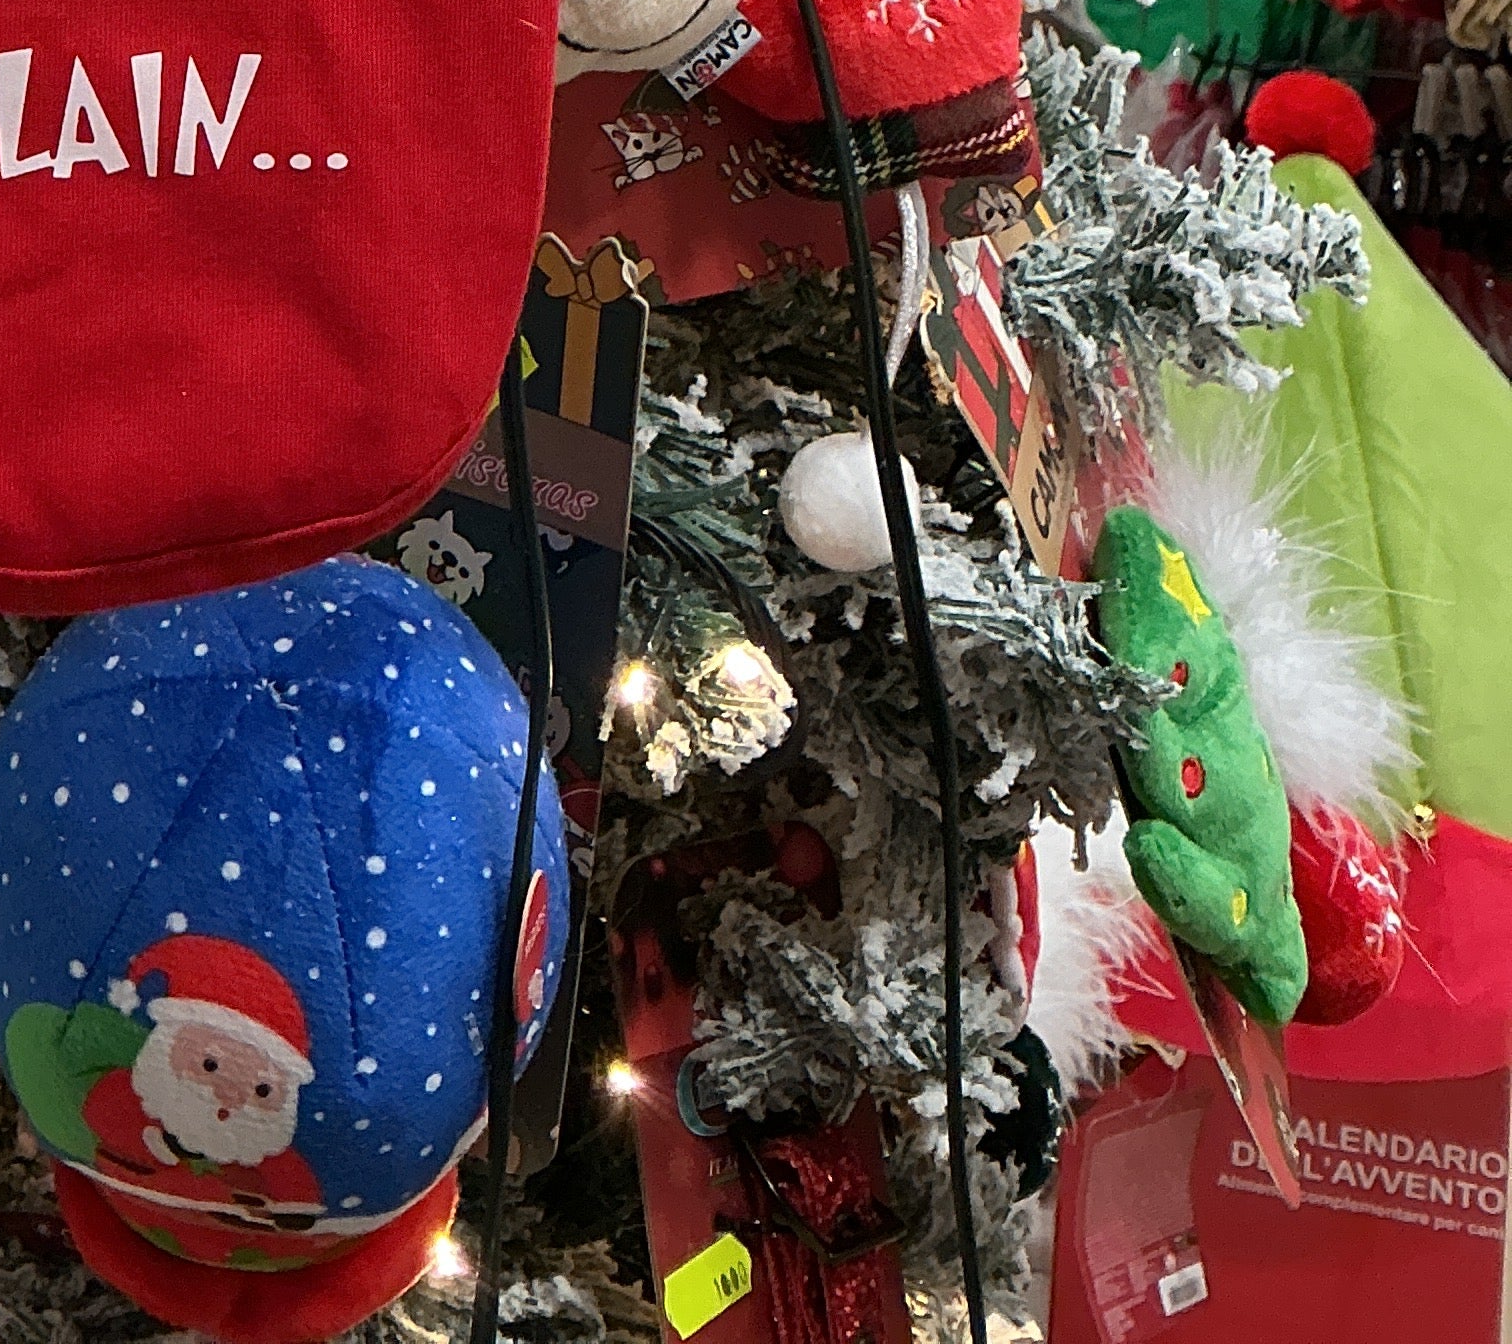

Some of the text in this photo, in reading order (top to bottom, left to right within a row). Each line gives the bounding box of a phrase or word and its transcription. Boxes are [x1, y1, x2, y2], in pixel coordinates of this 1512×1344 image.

[675, 19, 752, 92] CAMON
[1231, 1140, 1505, 1215] DL'AVVENTO
[1293, 1117, 1506, 1179] ALENDARIO
